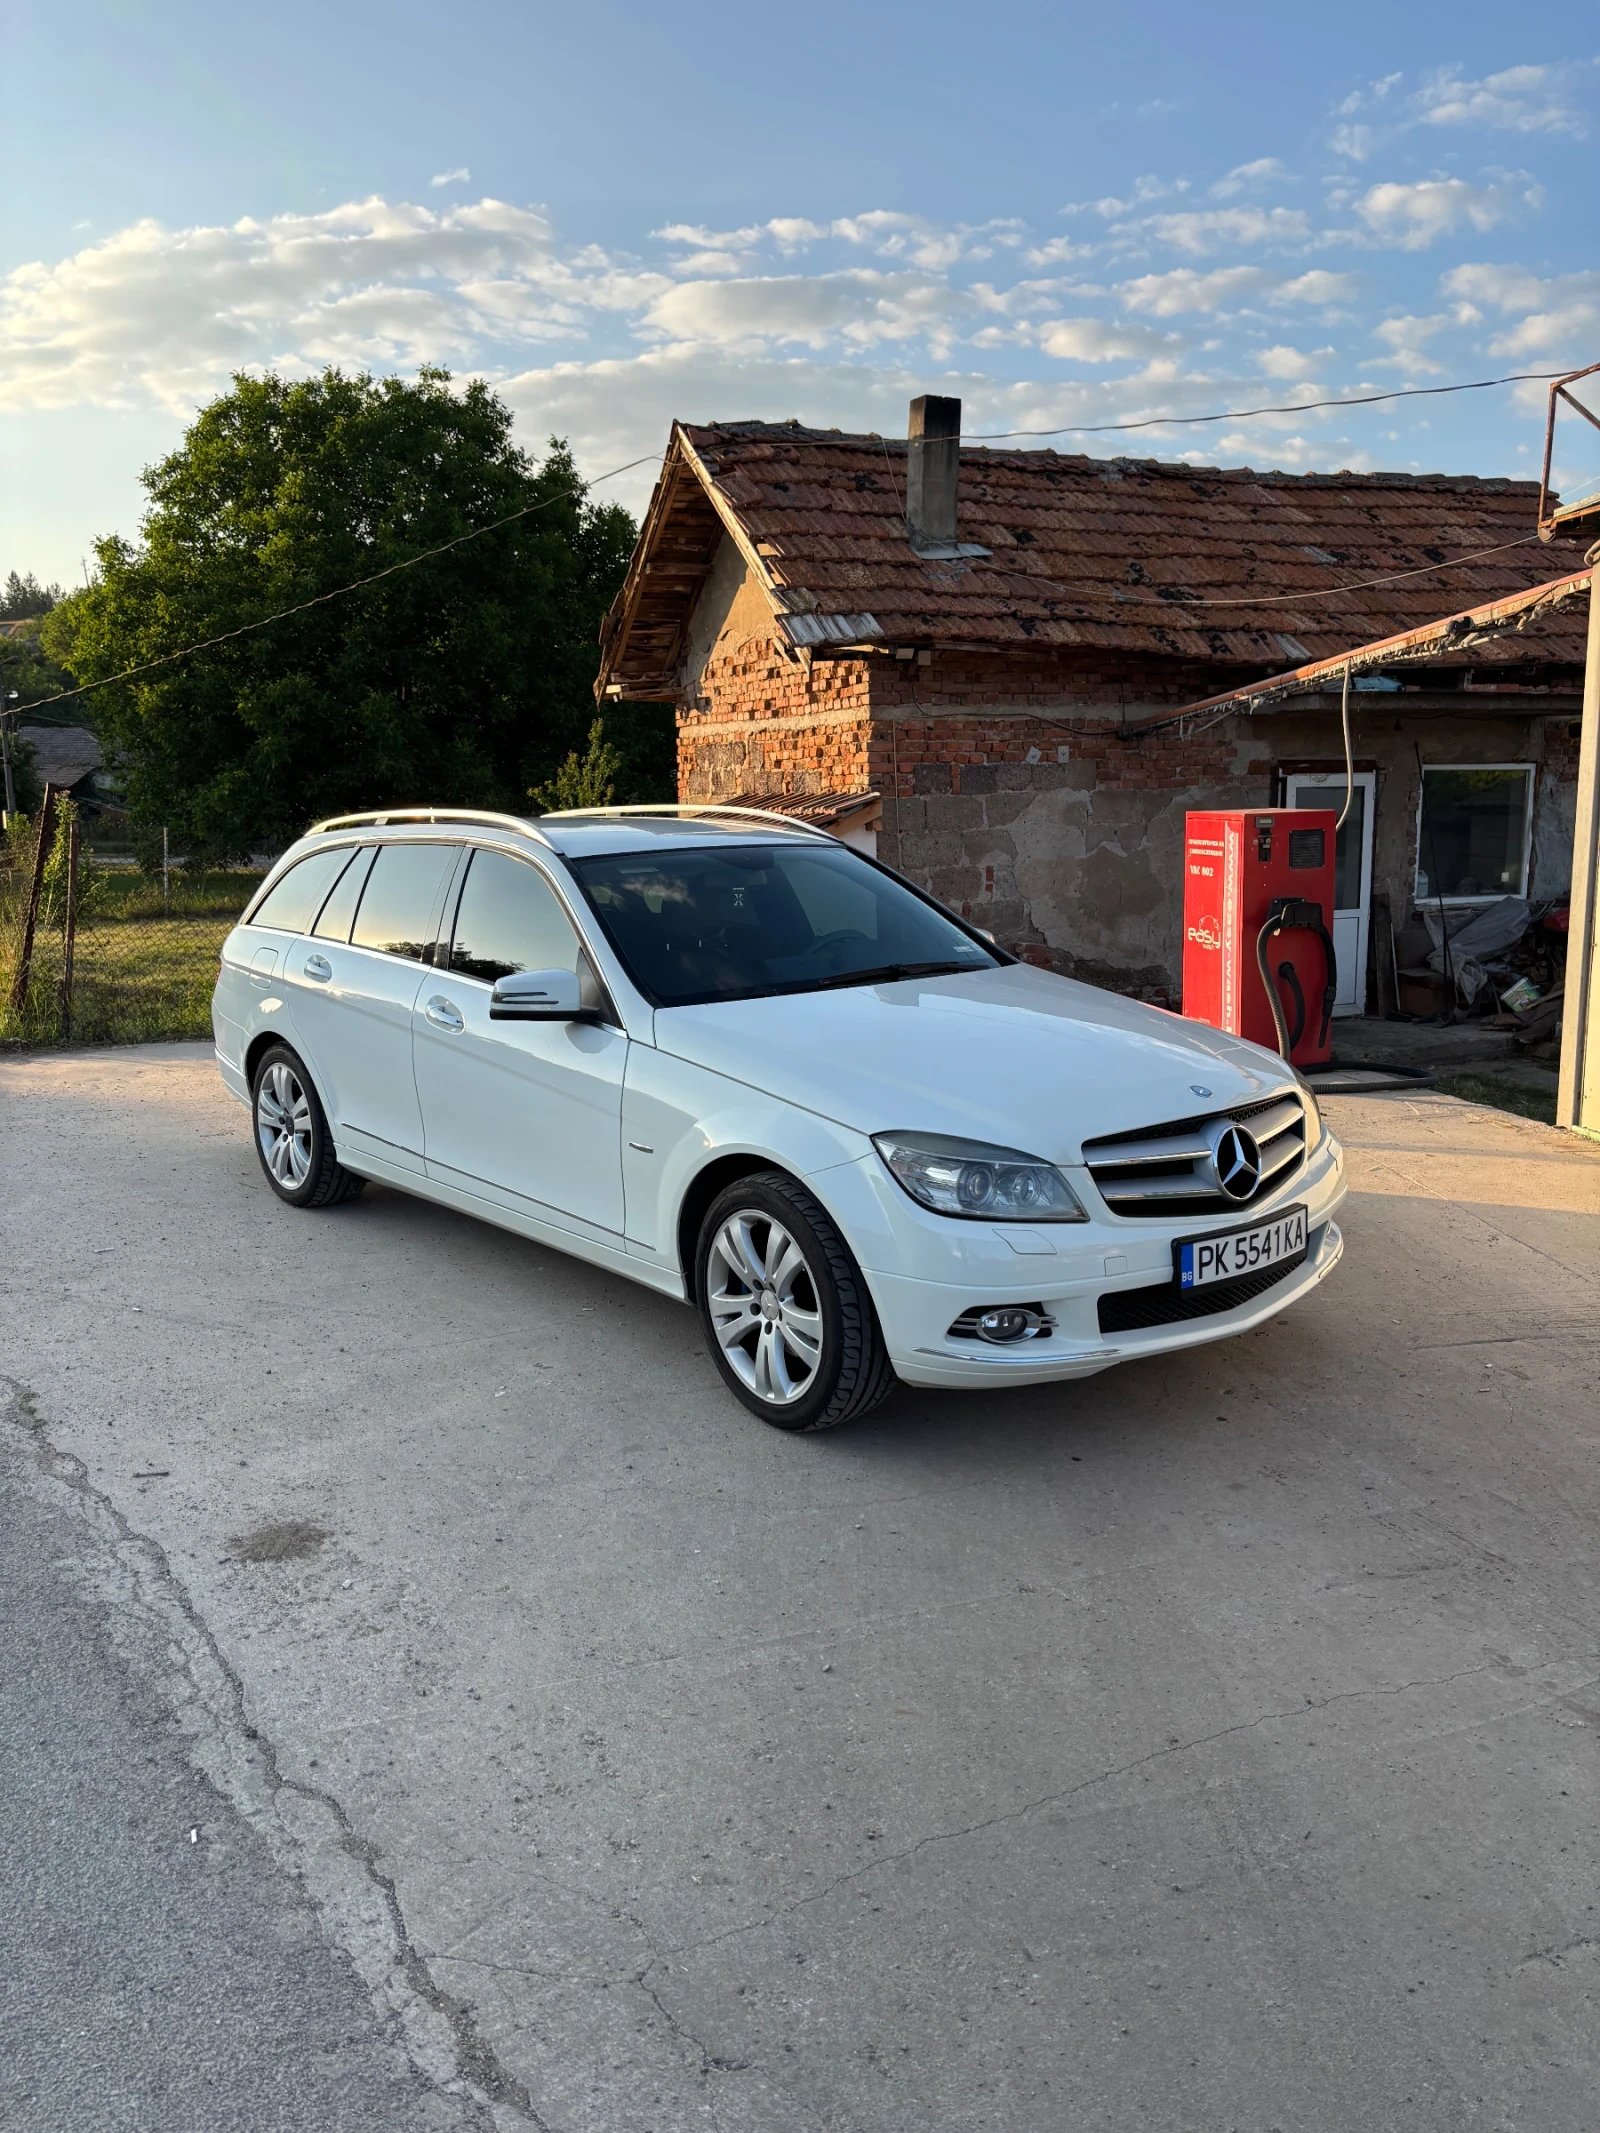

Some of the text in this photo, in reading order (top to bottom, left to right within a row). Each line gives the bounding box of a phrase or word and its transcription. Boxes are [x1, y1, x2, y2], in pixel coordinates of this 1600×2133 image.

[1202, 866, 1214, 877] 802
[1188, 927, 1220, 949] easy
[1198, 1240, 1229, 1280] PK
[1182, 1271, 1193, 1282] BG
